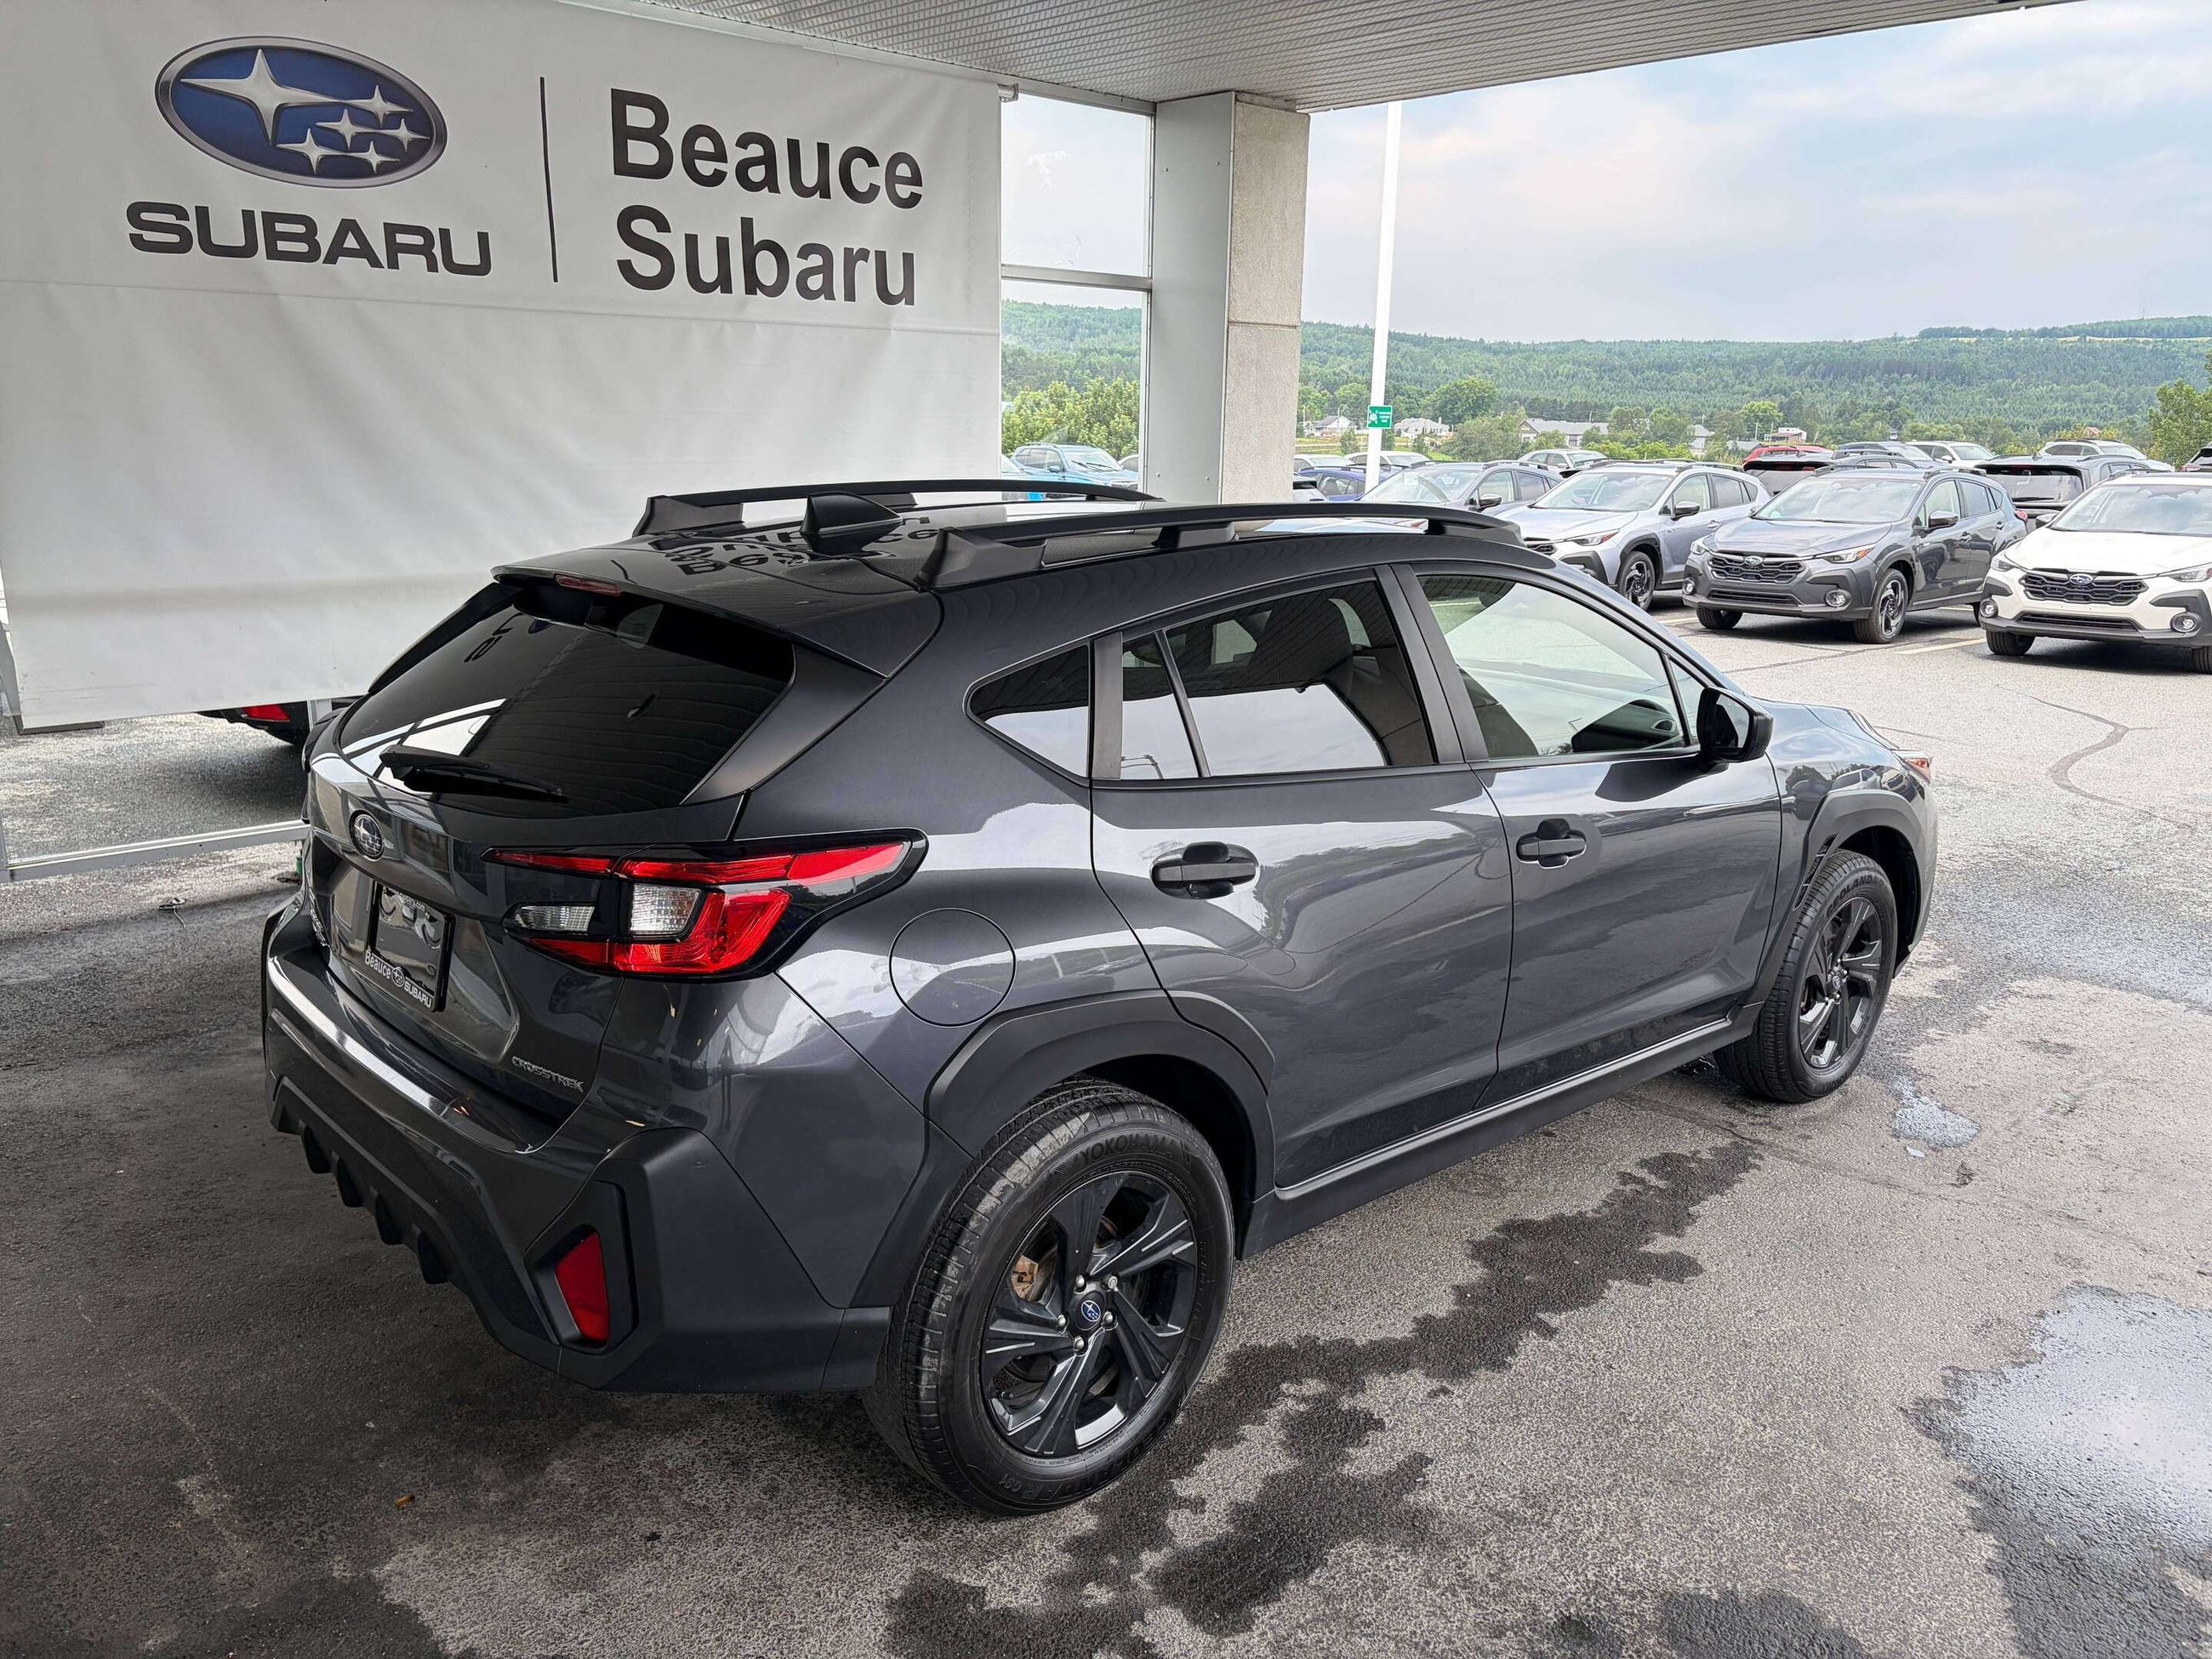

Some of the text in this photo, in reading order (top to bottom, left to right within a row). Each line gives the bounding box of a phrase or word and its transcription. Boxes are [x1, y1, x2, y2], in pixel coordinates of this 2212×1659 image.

[610, 88, 923, 209] Beauce
[126, 201, 492, 276] SUBARU
[616, 204, 915, 306] Subaru
[364, 949, 433, 1008] Beauce SUBARU
[511, 1056, 584, 1092] CROSSTREK
[1080, 1132, 1178, 1166] YOKOHAMA
